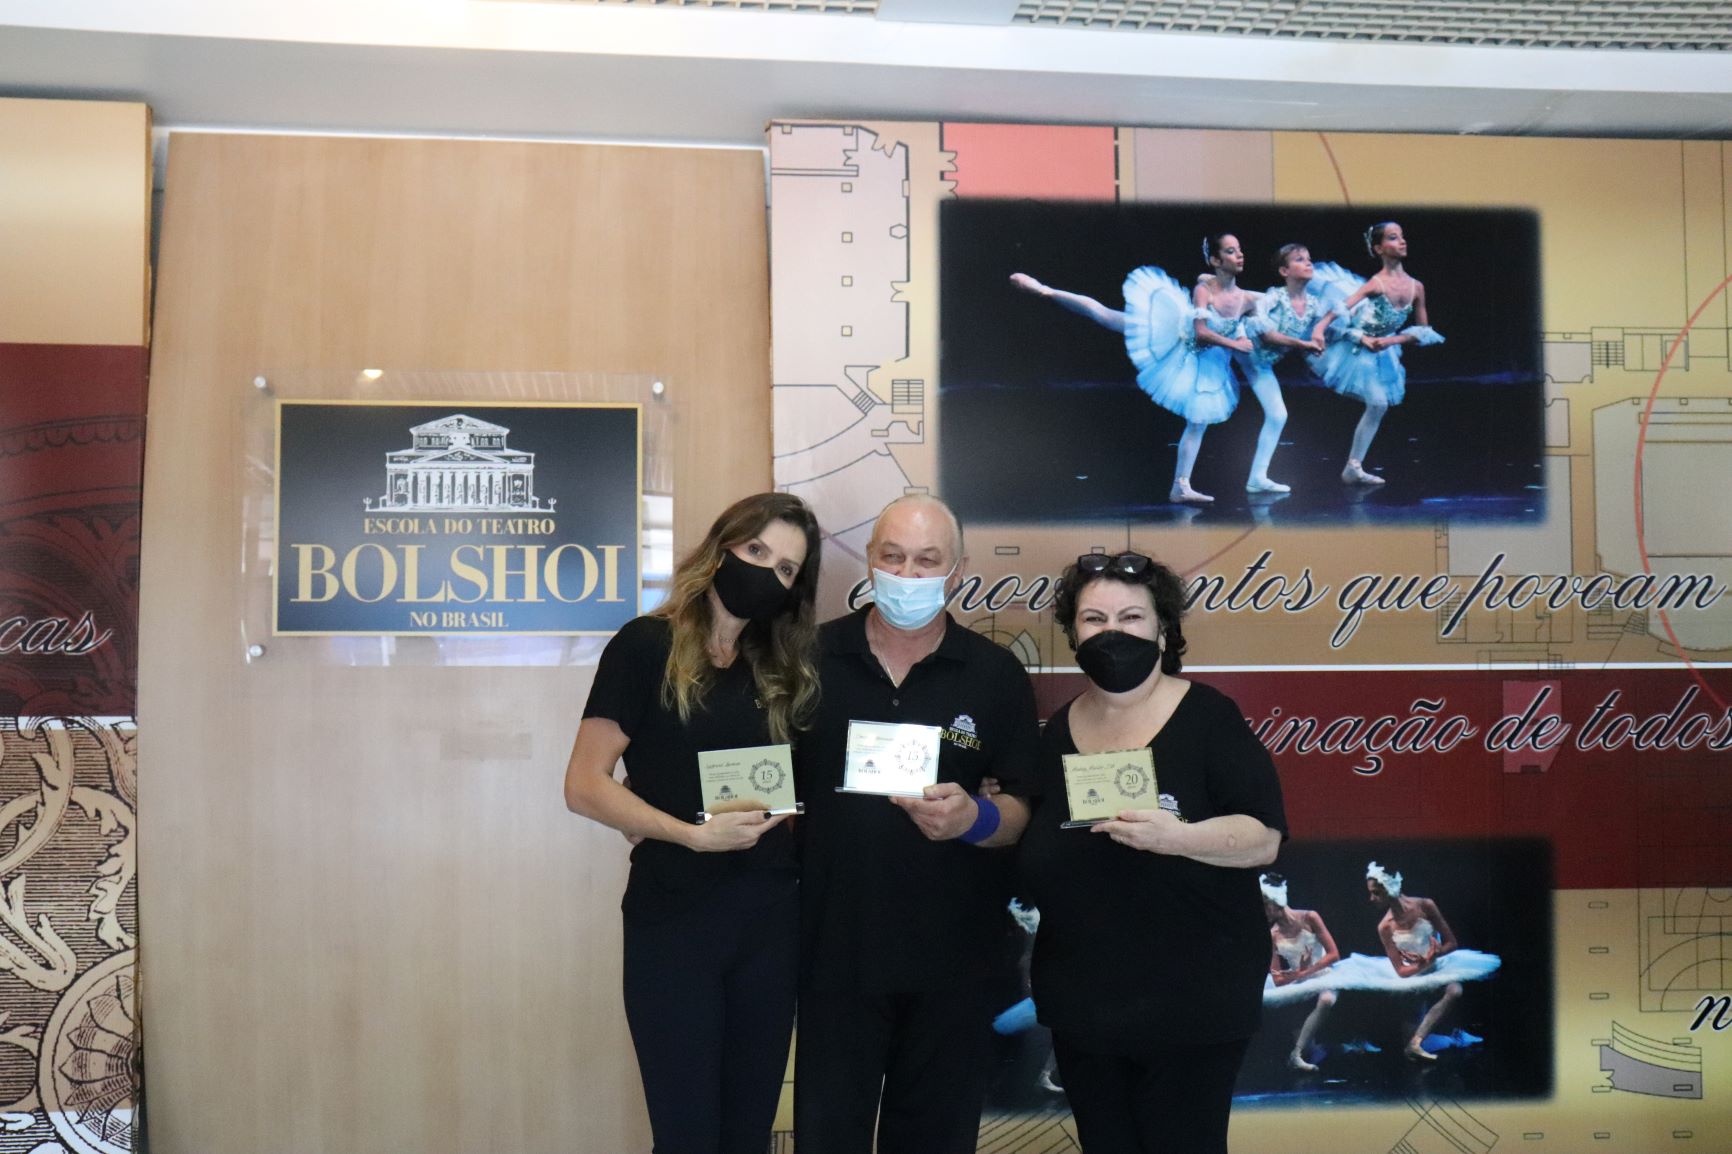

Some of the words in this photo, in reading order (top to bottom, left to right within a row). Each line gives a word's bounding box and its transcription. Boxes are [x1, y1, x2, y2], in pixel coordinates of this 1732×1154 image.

[363, 517, 437, 535] ESCOLA
[444, 519, 473, 535] DO
[476, 518, 556, 535] TEATRO
[289, 542, 626, 603] BOLSHOI
[1330, 574, 1460, 649] que
[1441, 552, 1727, 636] povoam
[410, 612, 437, 627] NO
[441, 612, 509, 628] BRASIL
[1484, 686, 1572, 751] de
[761, 769, 773, 781] 15
[1125, 773, 1139, 785] 20
